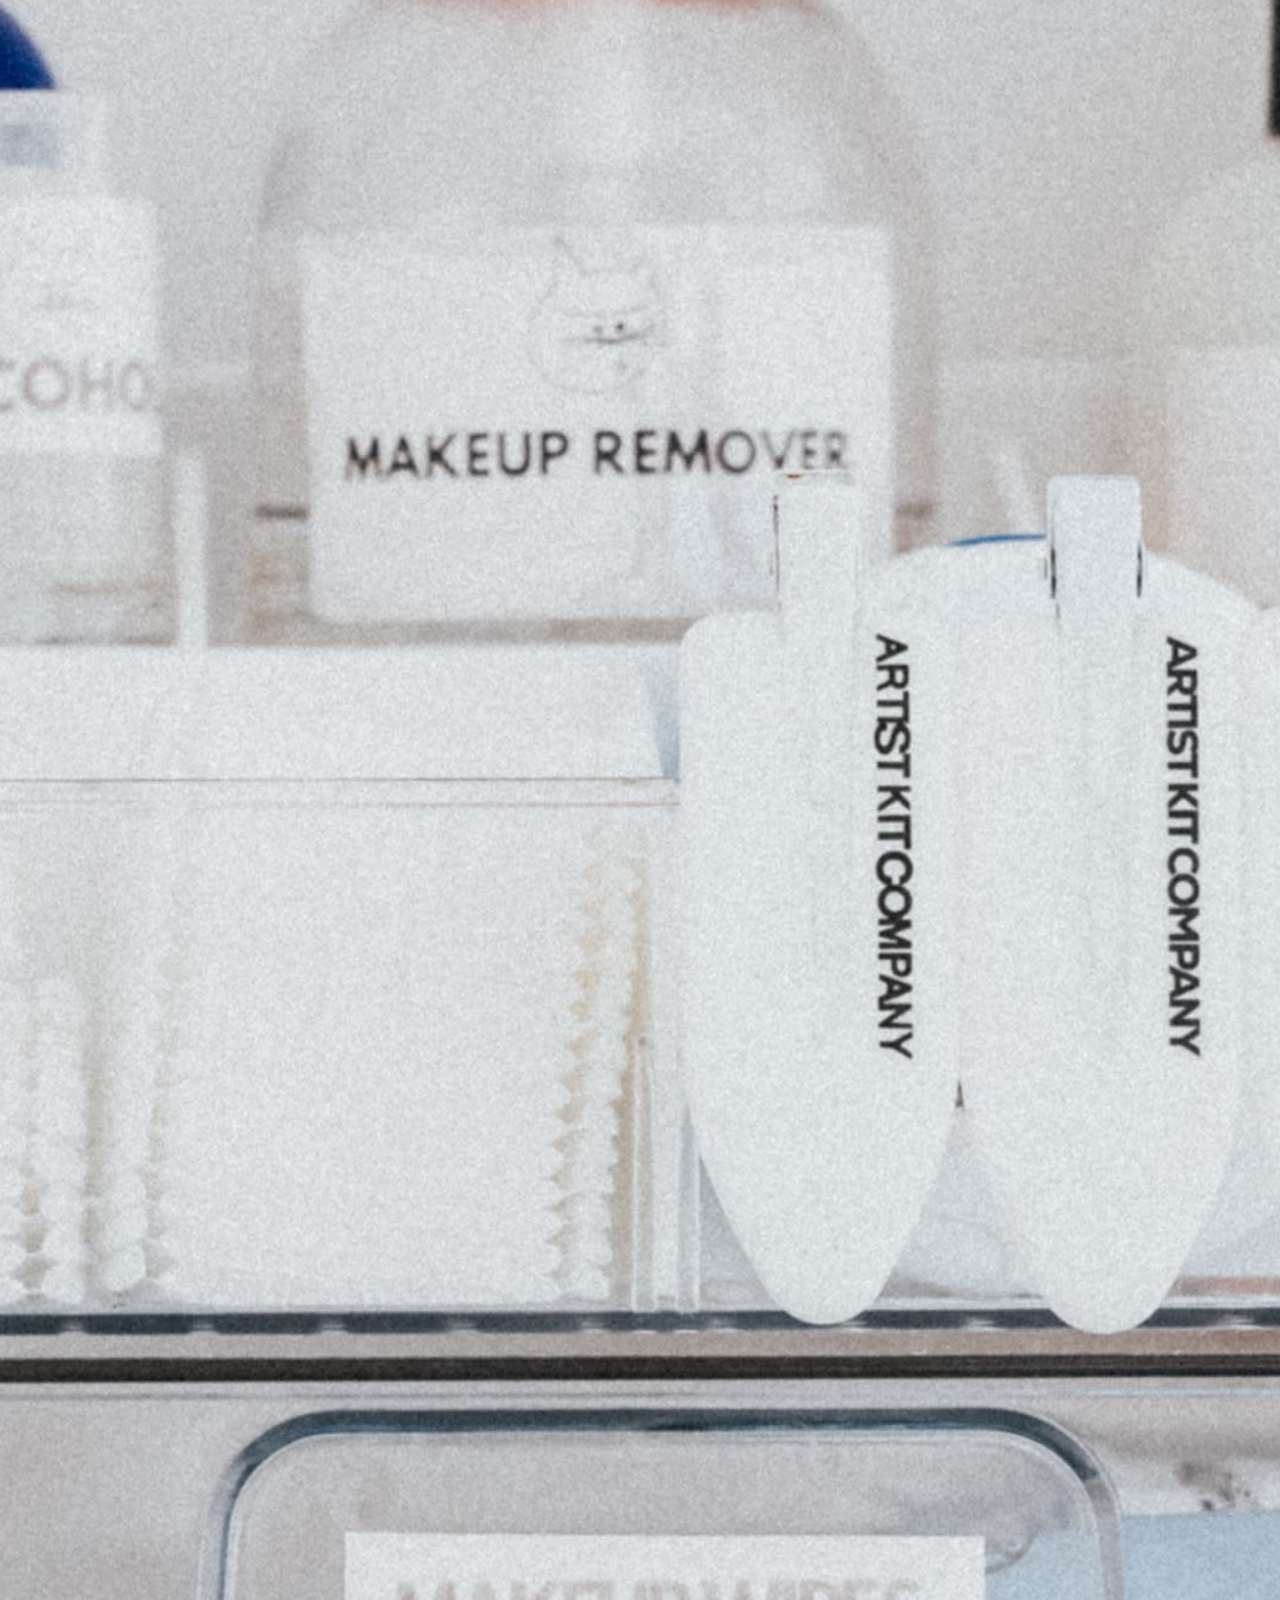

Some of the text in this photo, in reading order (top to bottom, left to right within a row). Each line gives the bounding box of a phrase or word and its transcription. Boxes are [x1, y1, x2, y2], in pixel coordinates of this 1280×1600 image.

[344, 429, 848, 480] MAKEUP REMOVER
[874, 634, 914, 1059] ARTIST KIT COMPANY
[1166, 637, 1201, 1057] ARTIST KIT COMPANY
